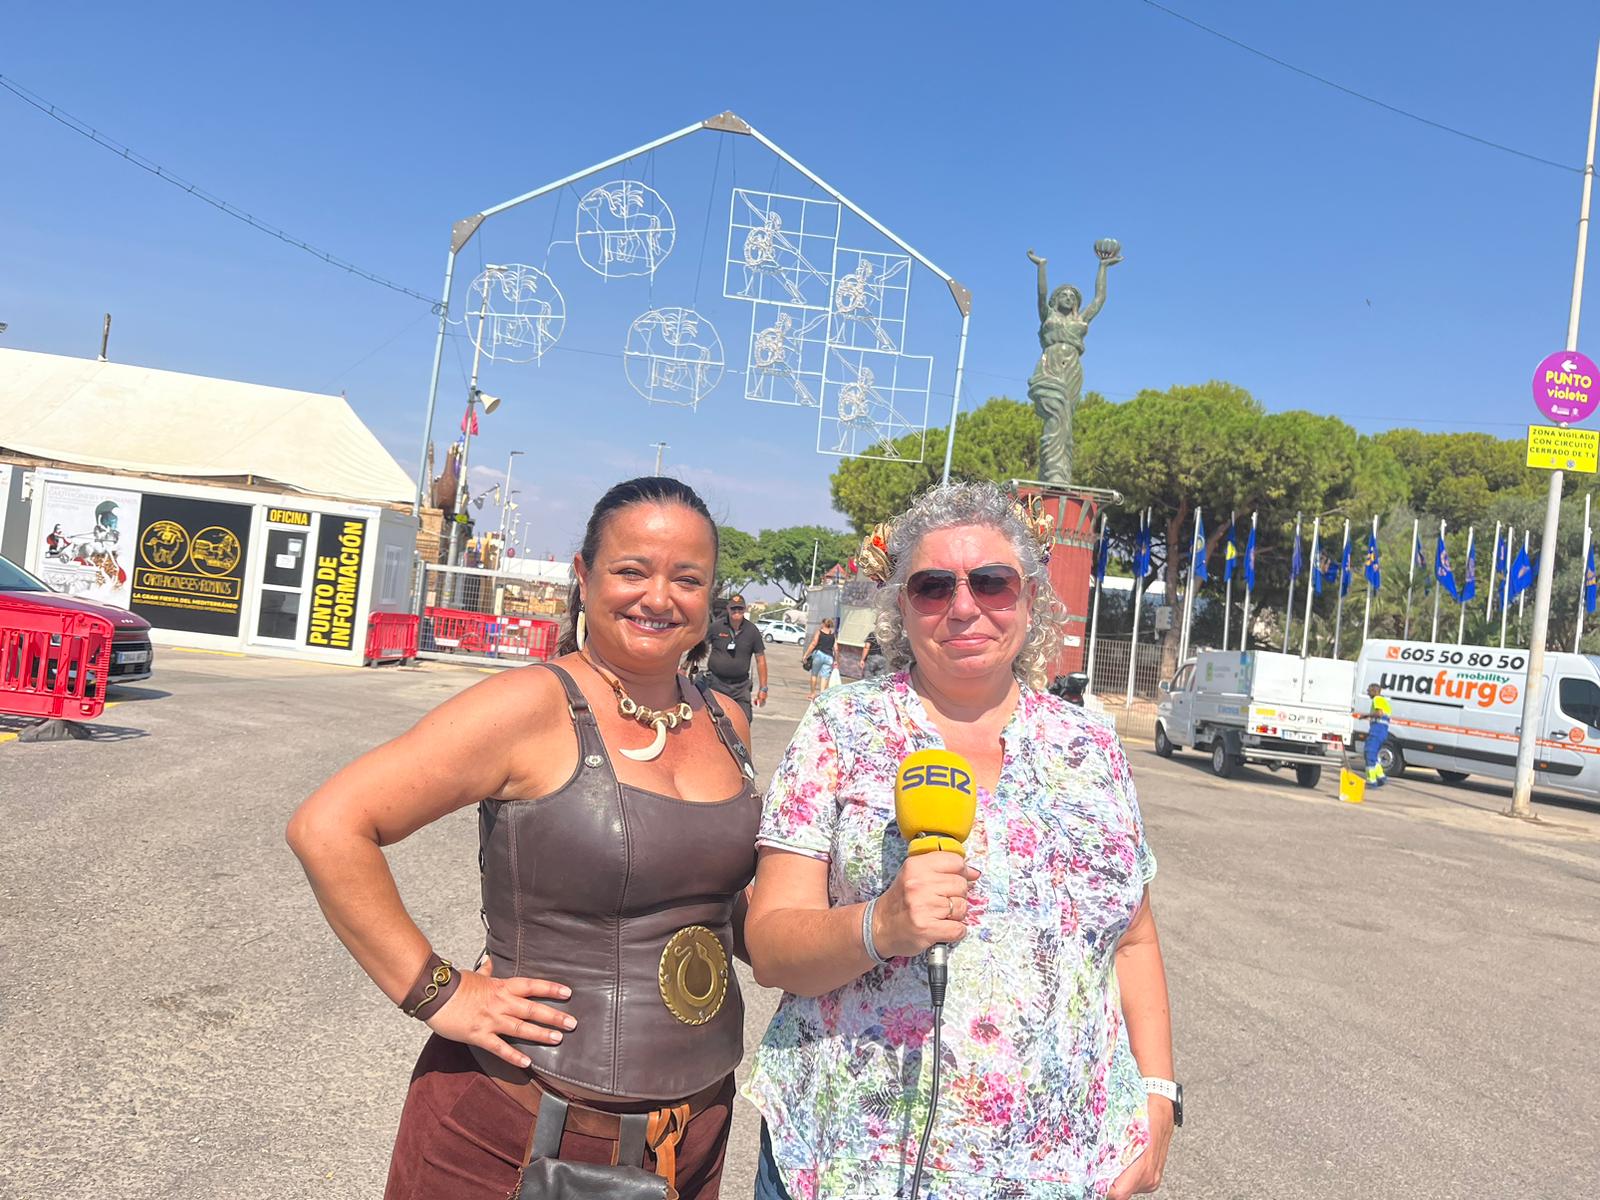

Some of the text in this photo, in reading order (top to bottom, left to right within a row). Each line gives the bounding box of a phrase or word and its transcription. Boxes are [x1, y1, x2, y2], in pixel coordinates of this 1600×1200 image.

[1545, 370, 1592, 389] PUNTO
[1547, 386, 1588, 403] violeta
[1532, 428, 1596, 441] ZONA VIGILADA
[1529, 446, 1570, 457] CERRADO
[1572, 449, 1583, 458] DE
[1533, 437, 1594, 450] CON CIRCUITO
[269, 509, 309, 526] OFICINA
[330, 520, 364, 648] INFORMACIÓN
[309, 555, 338, 645] PUNTO DE
[1401, 647, 1525, 670] 605 50 80 50
[1456, 671, 1511, 684] mobility
[901, 765, 971, 795] SER
